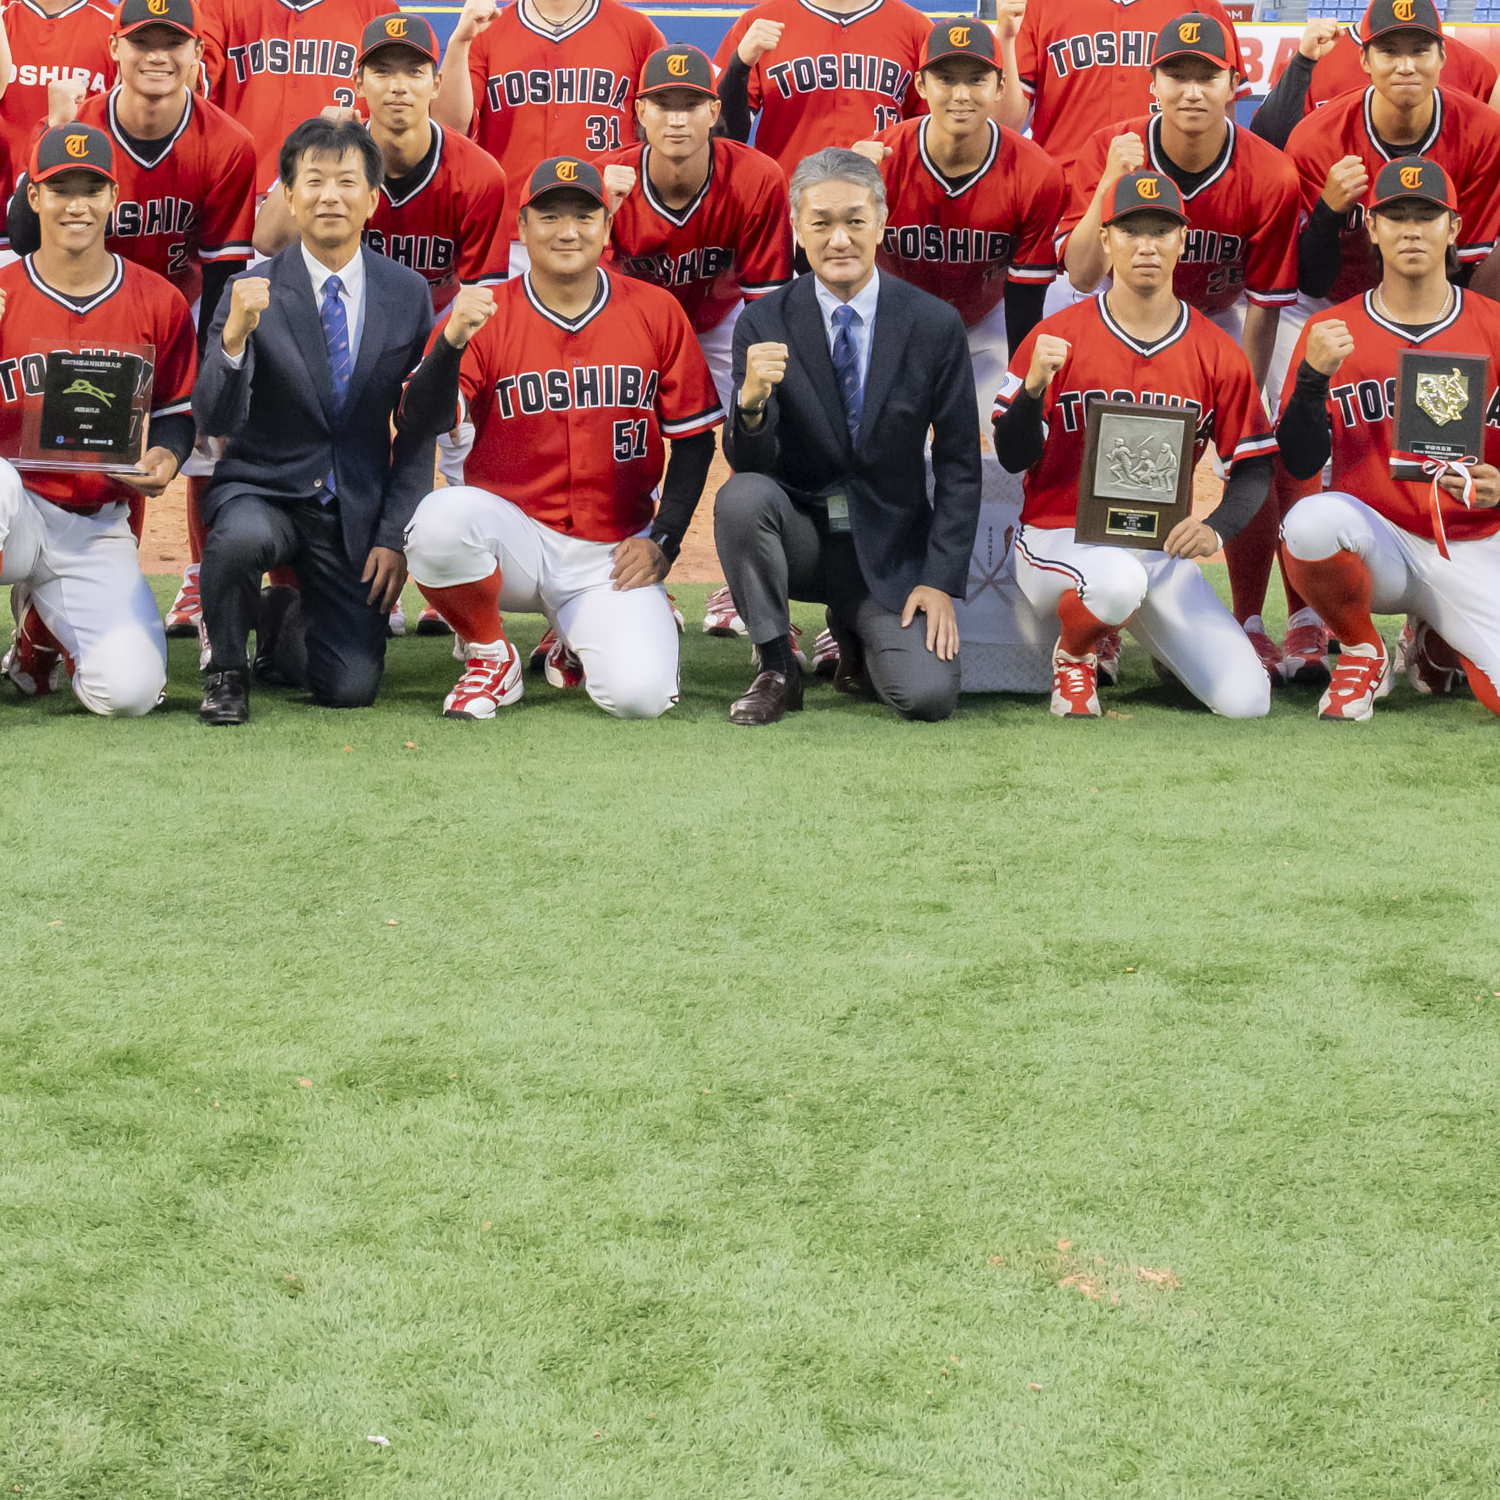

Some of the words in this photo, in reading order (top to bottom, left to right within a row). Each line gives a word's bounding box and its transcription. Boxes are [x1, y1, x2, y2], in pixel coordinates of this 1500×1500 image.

[230, 39, 357, 83] TOSHIB
[1046, 30, 1158, 78] TOSHI
[487, 68, 630, 113] TOSHIBA
[586, 115, 622, 152] 31
[495, 365, 660, 420] TOSHIBA
[613, 418, 648, 462] 51
